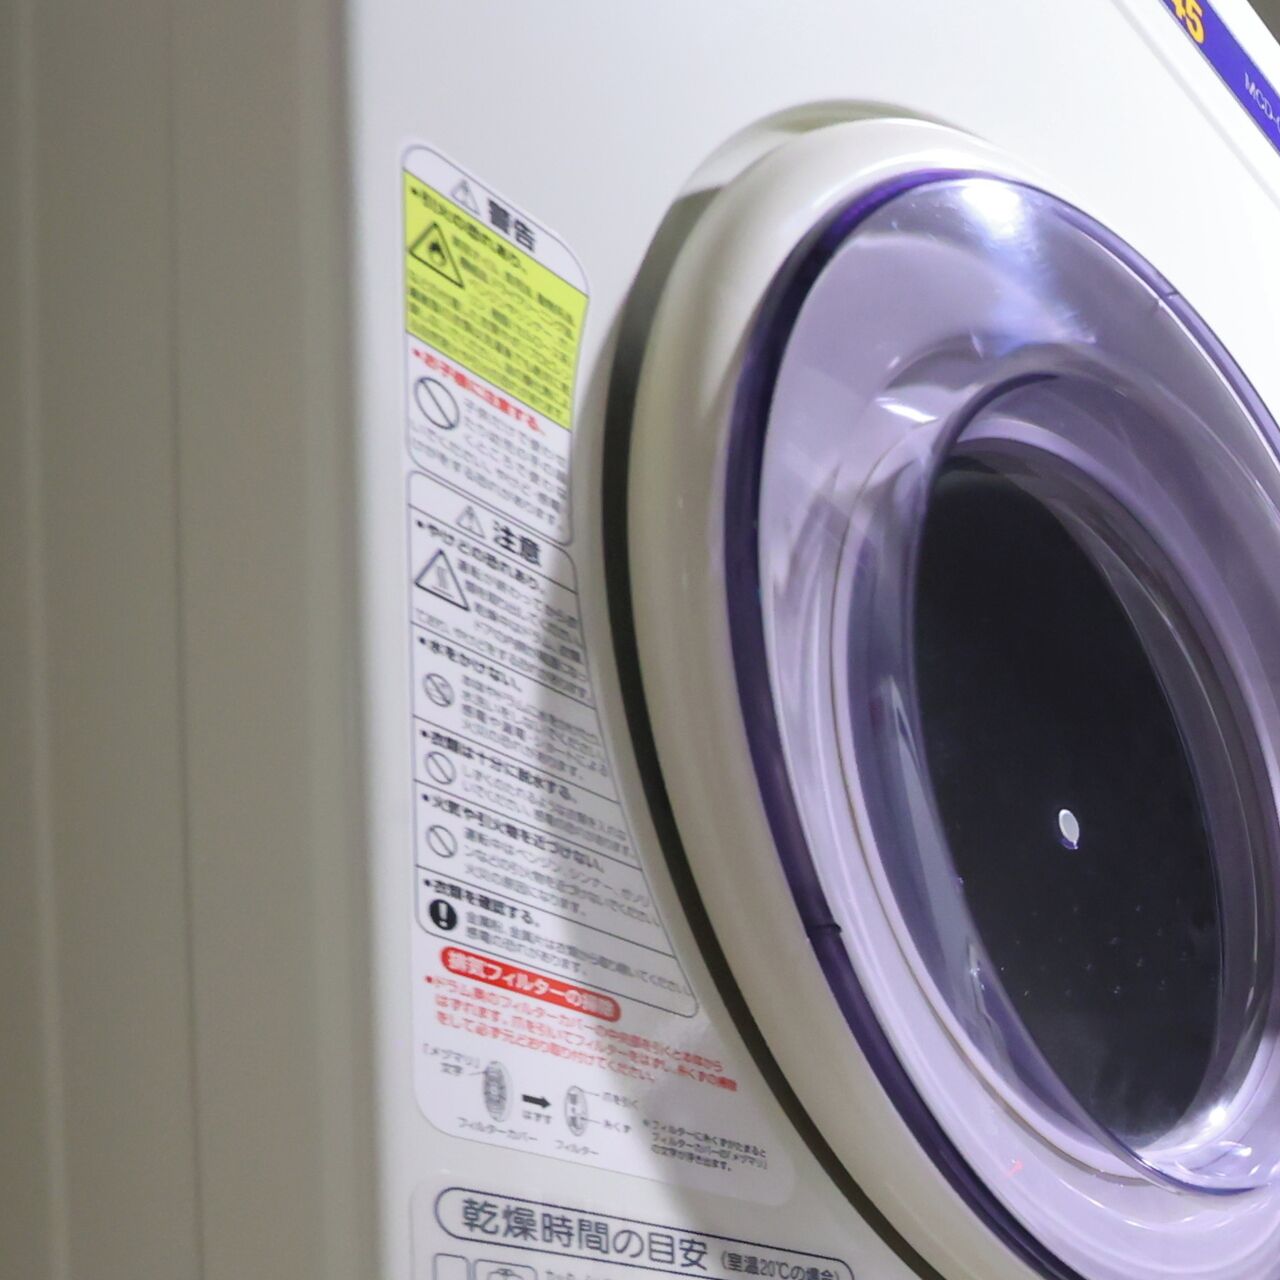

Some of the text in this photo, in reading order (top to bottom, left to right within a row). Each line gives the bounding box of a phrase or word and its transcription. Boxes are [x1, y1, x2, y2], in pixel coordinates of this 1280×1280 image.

[486, 199, 536, 253] 警告
[493, 519, 541, 567] 注意
[462, 1198, 708, 1271] 乾燥時間の目安
